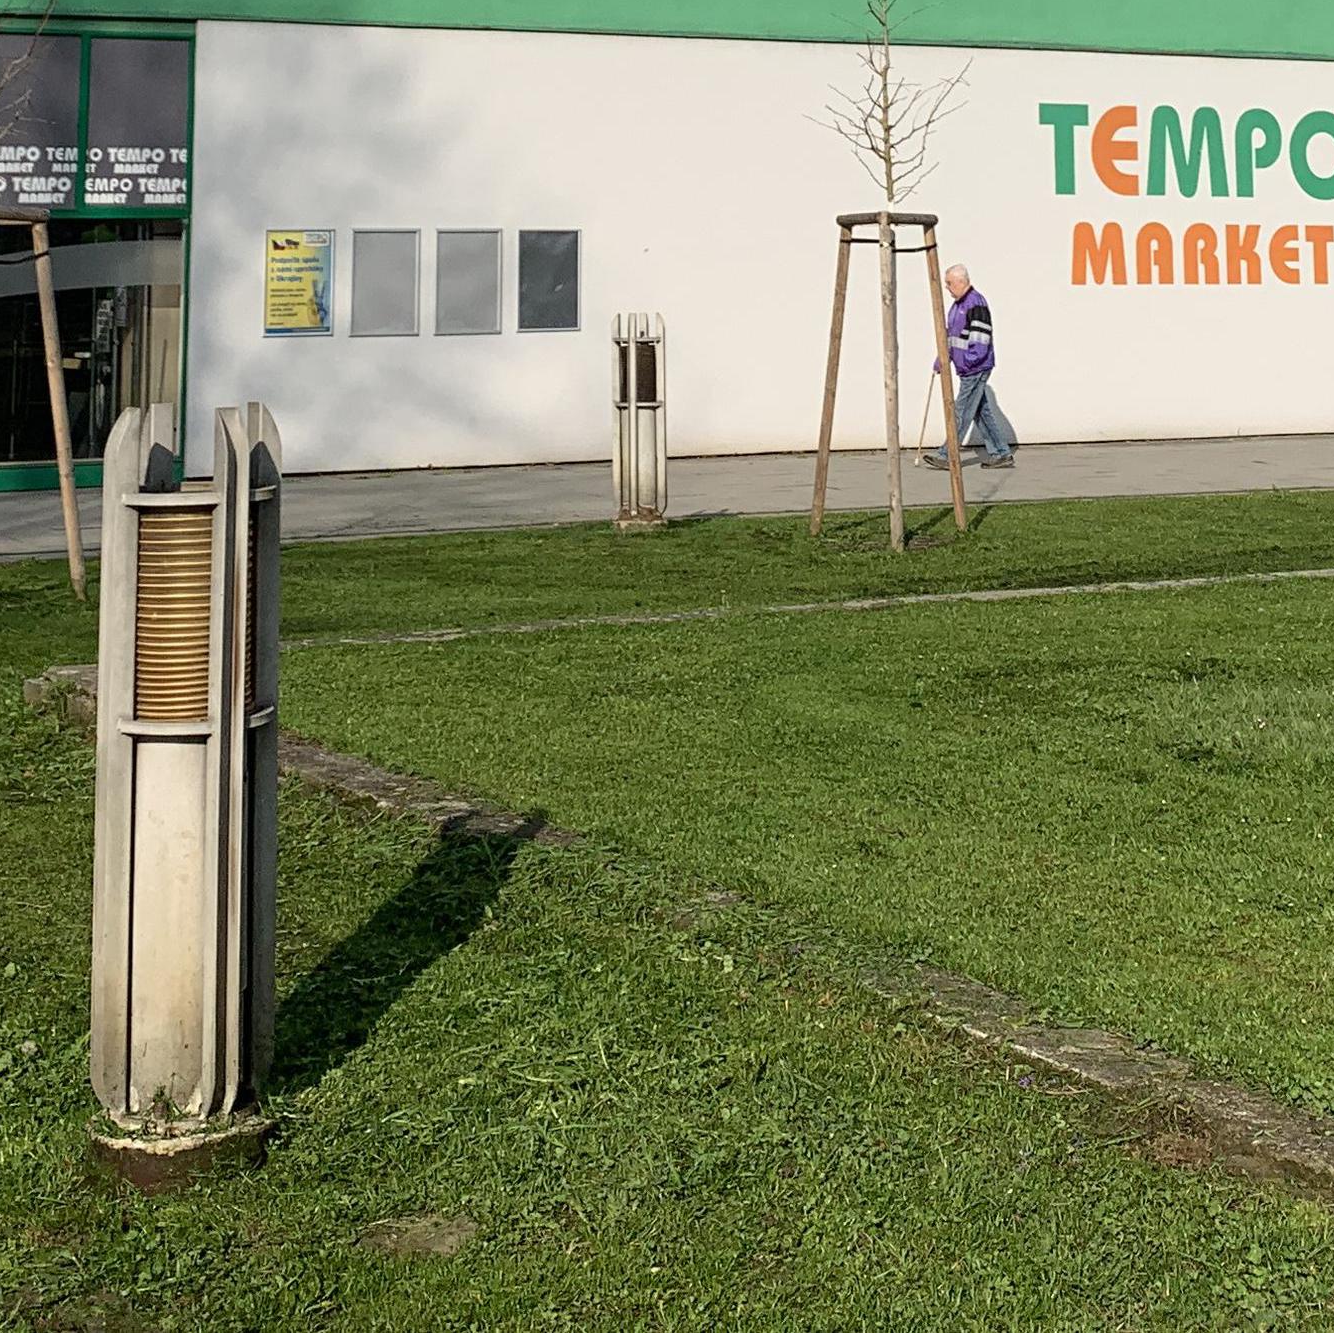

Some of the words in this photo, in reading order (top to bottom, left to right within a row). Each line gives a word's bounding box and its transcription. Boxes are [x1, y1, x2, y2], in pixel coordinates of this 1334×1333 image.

[107, 147, 165, 163] TEMPO
[12, 177, 72, 192] TEMPO
[85, 178, 133, 192] EMPO
[1071, 222, 1334, 285] MARKET
